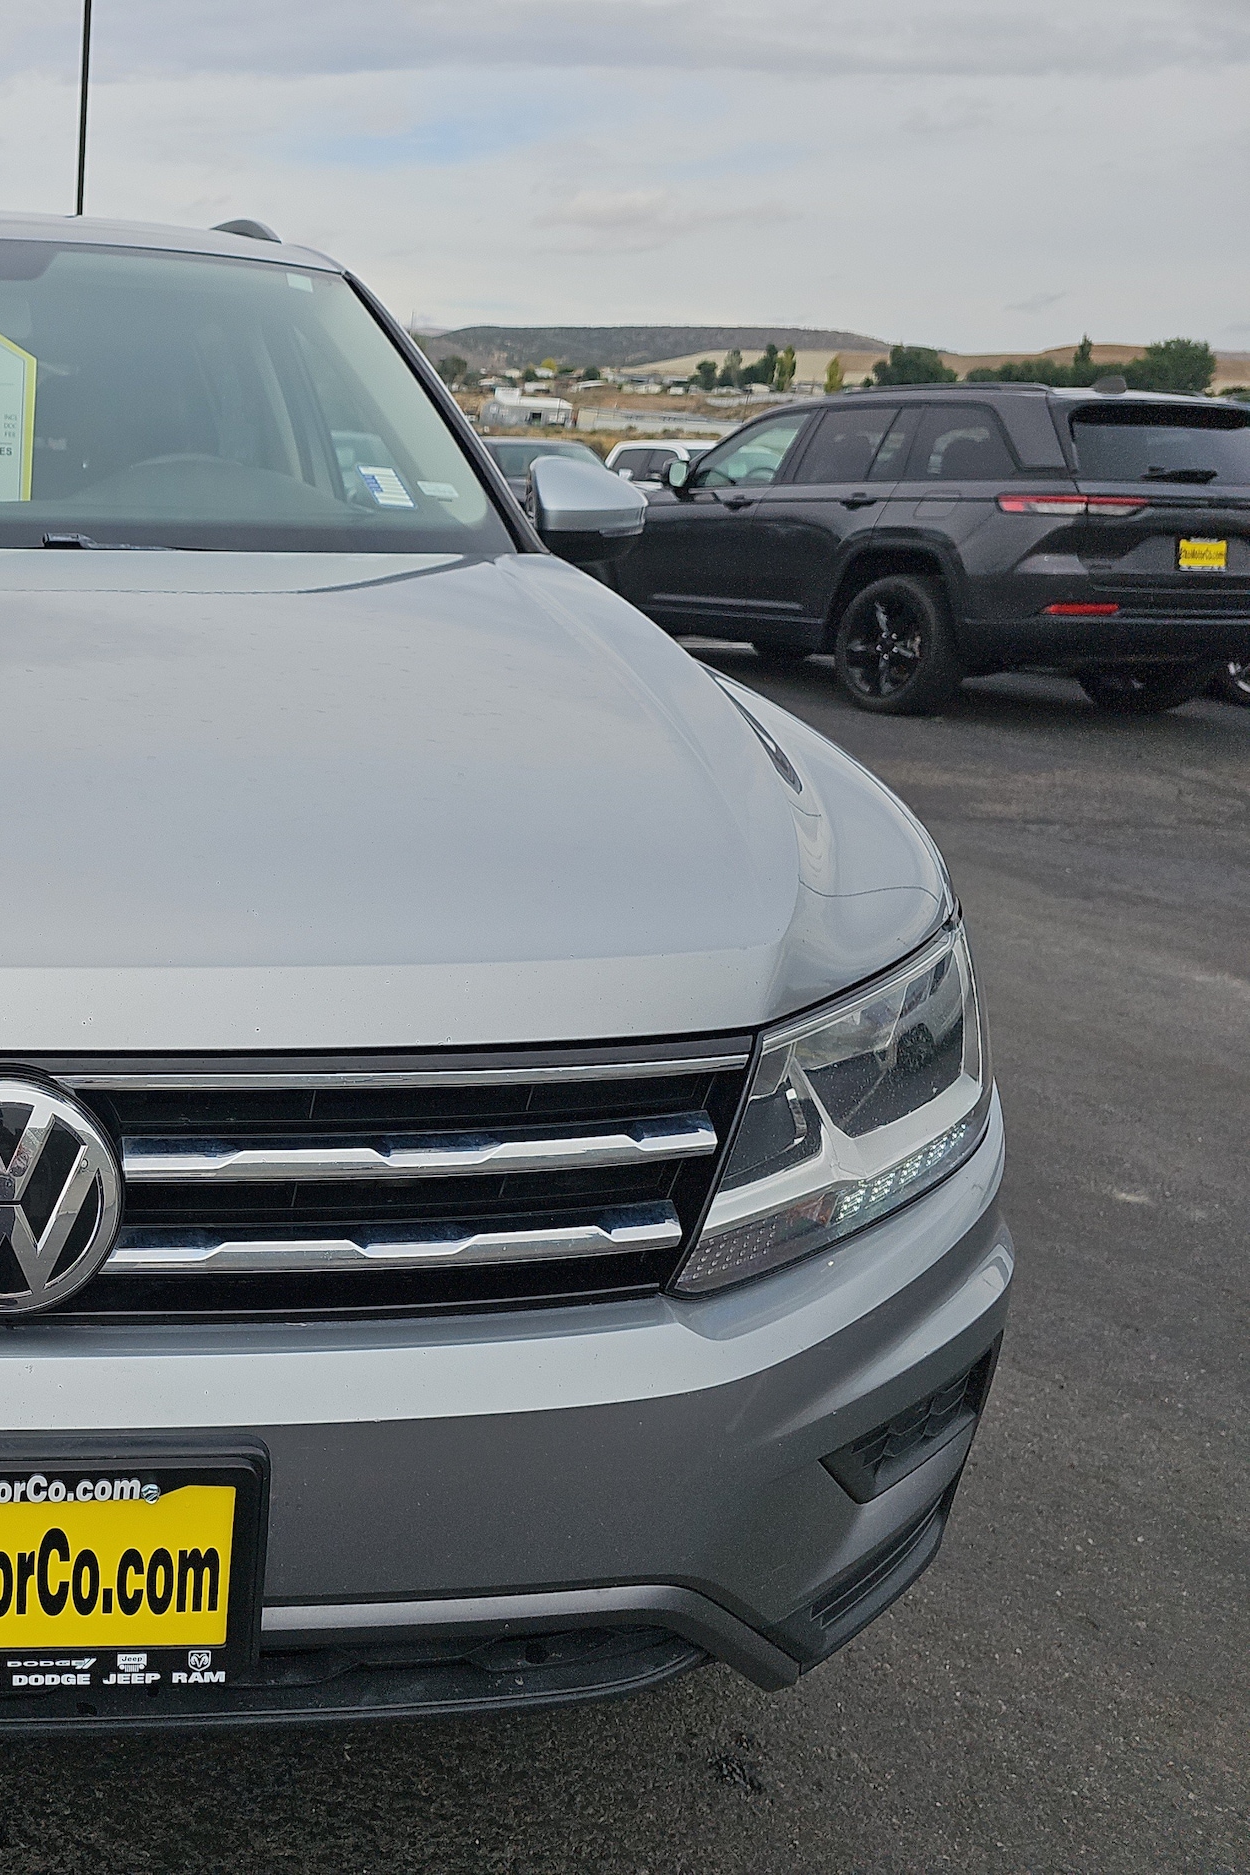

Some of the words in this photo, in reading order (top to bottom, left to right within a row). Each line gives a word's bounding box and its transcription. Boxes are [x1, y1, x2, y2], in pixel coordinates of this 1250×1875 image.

[121, 1655, 143, 1663] Jeep
[12, 1673, 91, 1686] DODGE
[103, 1672, 161, 1685] JEEP
[171, 1671, 226, 1684] RAM
